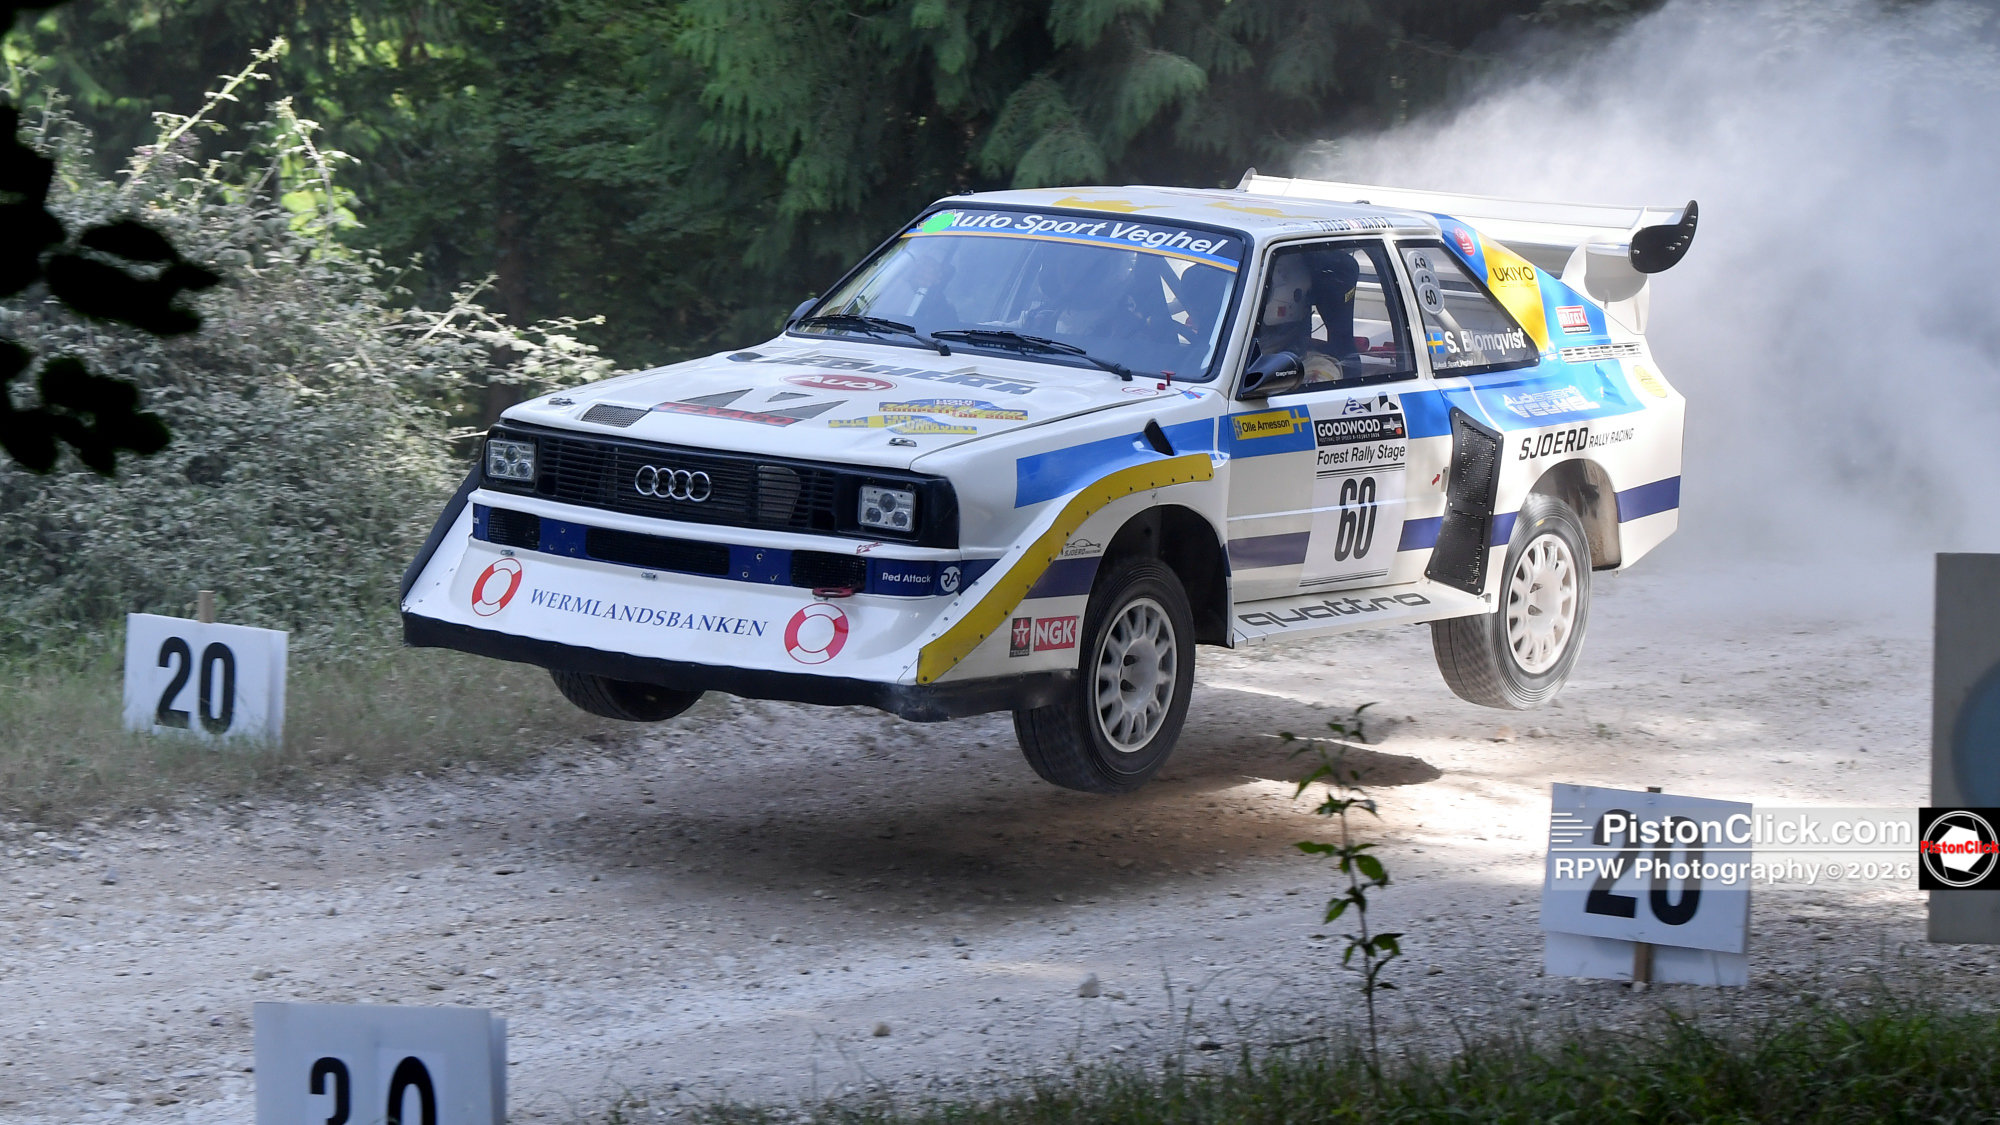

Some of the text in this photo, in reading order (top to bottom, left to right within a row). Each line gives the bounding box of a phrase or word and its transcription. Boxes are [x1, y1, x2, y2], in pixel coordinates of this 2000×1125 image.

[1014, 214, 1105, 235] Sport
[1107, 221, 1229, 256] Veghel
[1492, 265, 1535, 282] UKIYO
[1425, 289, 1437, 306] 60
[1444, 328, 1527, 356] S. Blomqvist
[1242, 422, 1257, 433] Olle
[1257, 419, 1290, 432] Arnesson
[1317, 418, 1381, 437] GOODWOOD
[1316, 444, 1406, 466] Forest Rally Stage
[1519, 427, 1635, 461] SJOERD RALLY RACING
[1334, 476, 1378, 562] 60
[882, 572, 932, 583] Red Attack
[530, 588, 769, 638] WERMLANDSBANKEN
[1238, 593, 1431, 628] quattro
[1035, 619, 1075, 647] NGK
[155, 636, 236, 735] 20
[1584, 808, 1703, 926] 20
